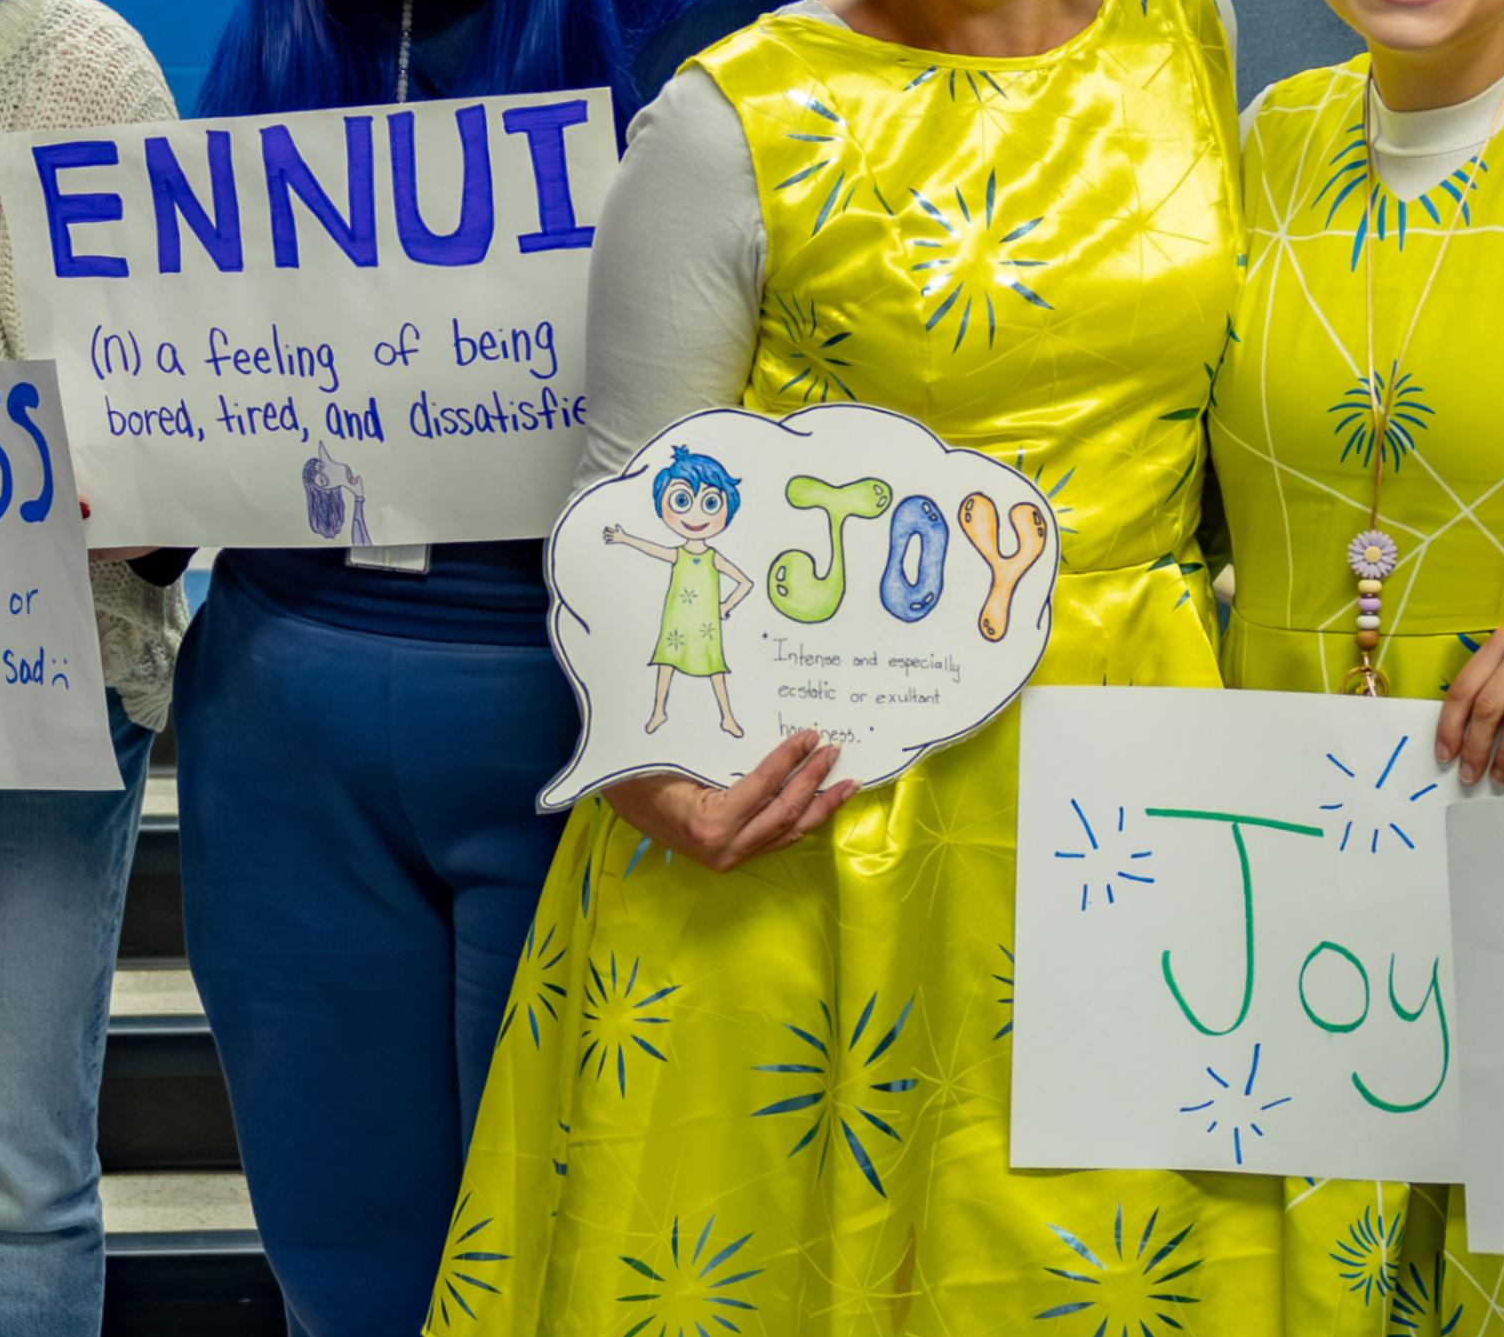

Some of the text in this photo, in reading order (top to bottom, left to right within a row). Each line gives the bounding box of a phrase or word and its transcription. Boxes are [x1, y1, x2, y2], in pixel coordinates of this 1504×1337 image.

[31, 98, 597, 280] ENNUI
[91, 317, 559, 393] (n) a feeling of being
[104, 394, 206, 442] bored,
[215, 394, 310, 443] tired,
[325, 397, 385, 443] and
[766, 474, 1048, 643] JOY
[9, 588, 39, 615] or
[772, 637, 961, 683] Intense and especially
[777, 679, 941, 704] ecstatic or exultant
[1145, 807, 1450, 1114] Joy
